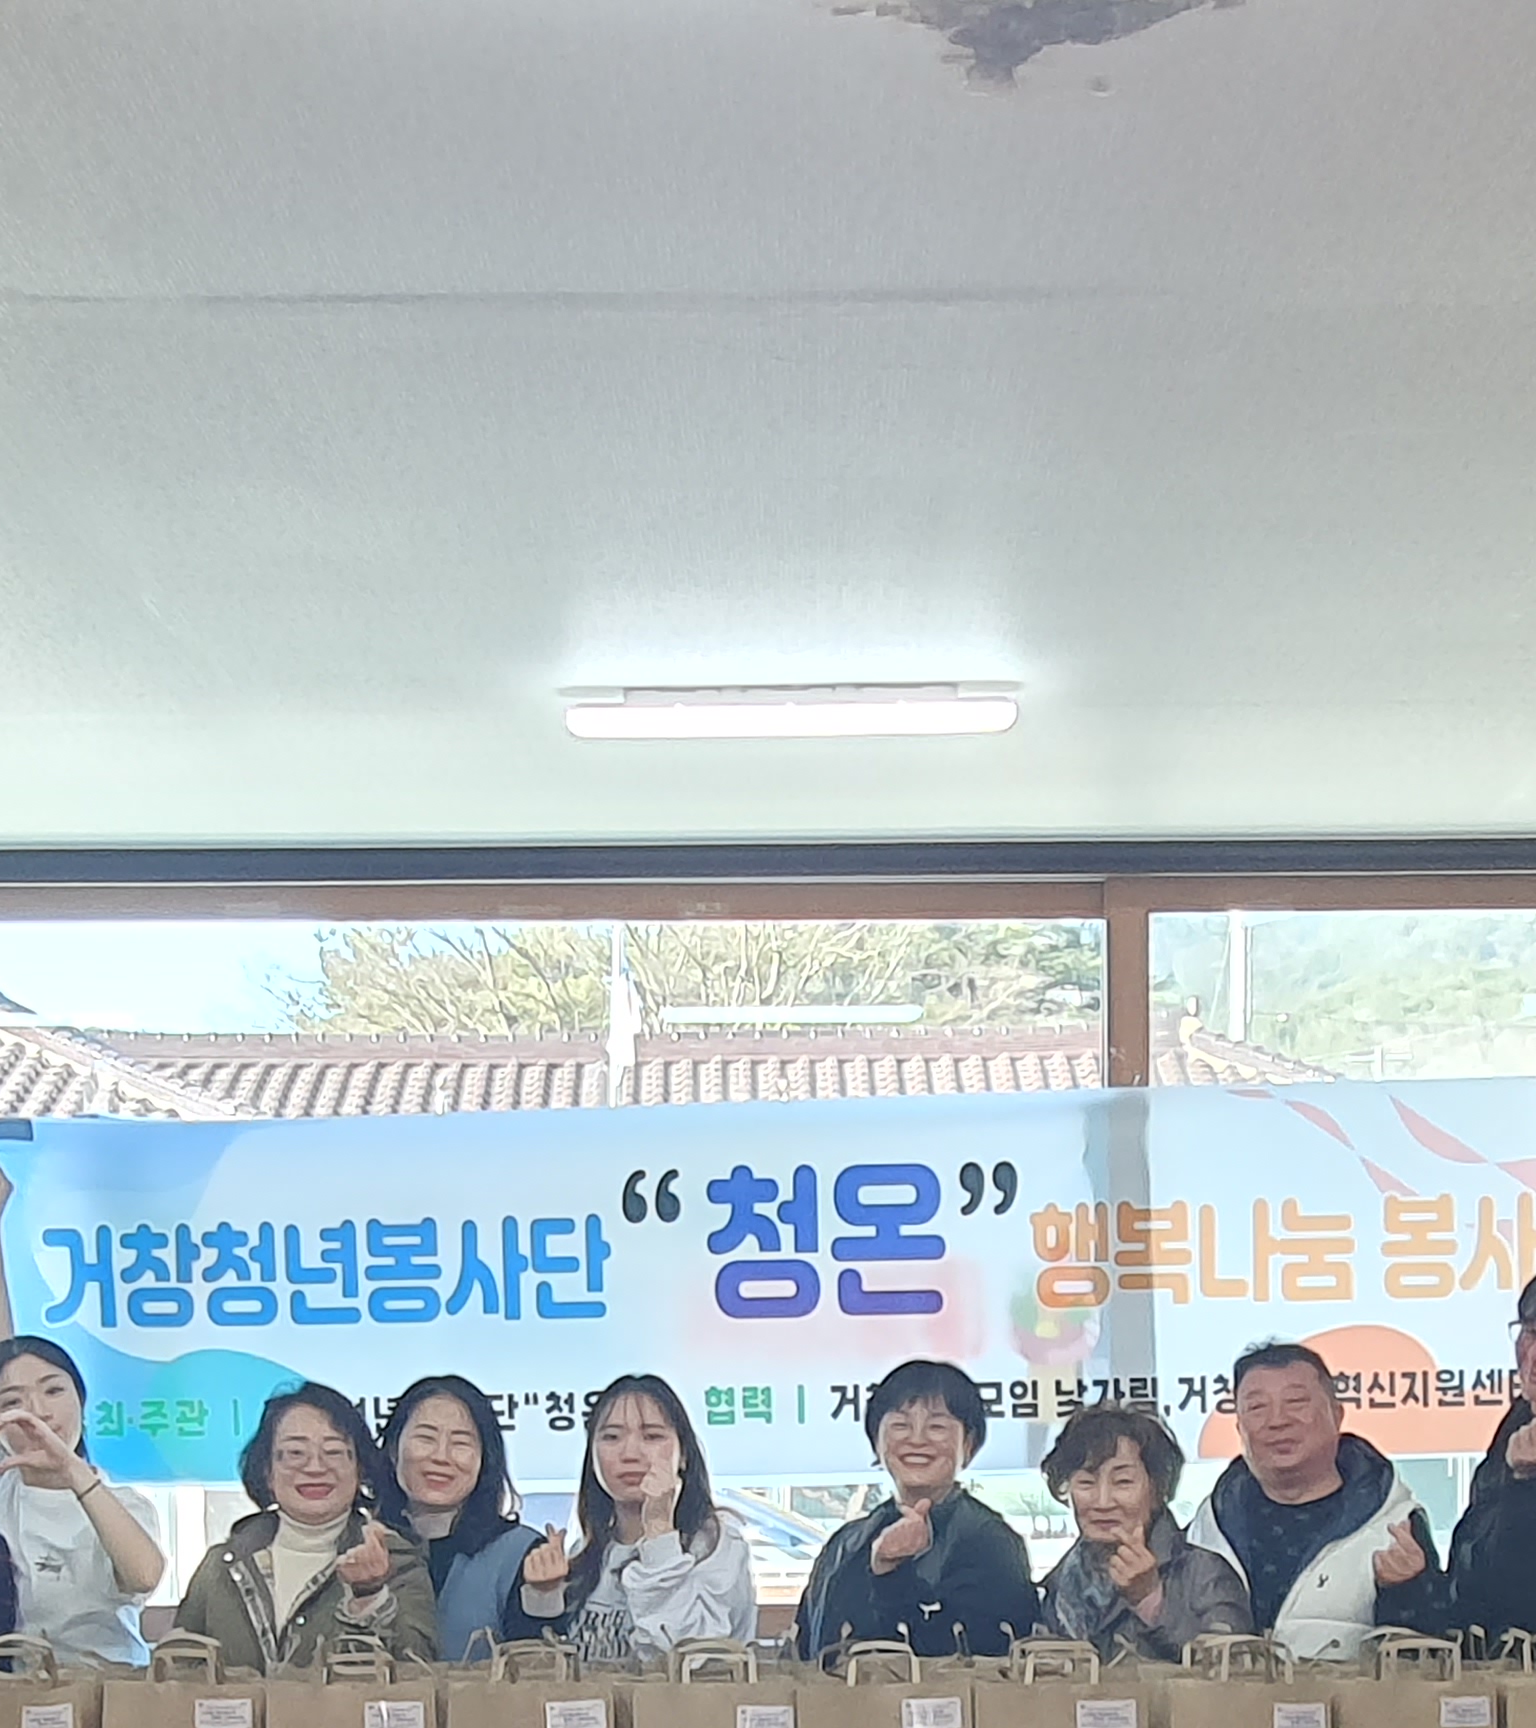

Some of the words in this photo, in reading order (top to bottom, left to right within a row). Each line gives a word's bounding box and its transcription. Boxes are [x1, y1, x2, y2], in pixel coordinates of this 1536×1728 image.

[41, 1213, 612, 1329] 거창청년봉사단
[1029, 1197, 1356, 1309] 행복나눔
[704, 1385, 773, 1425] 협력
